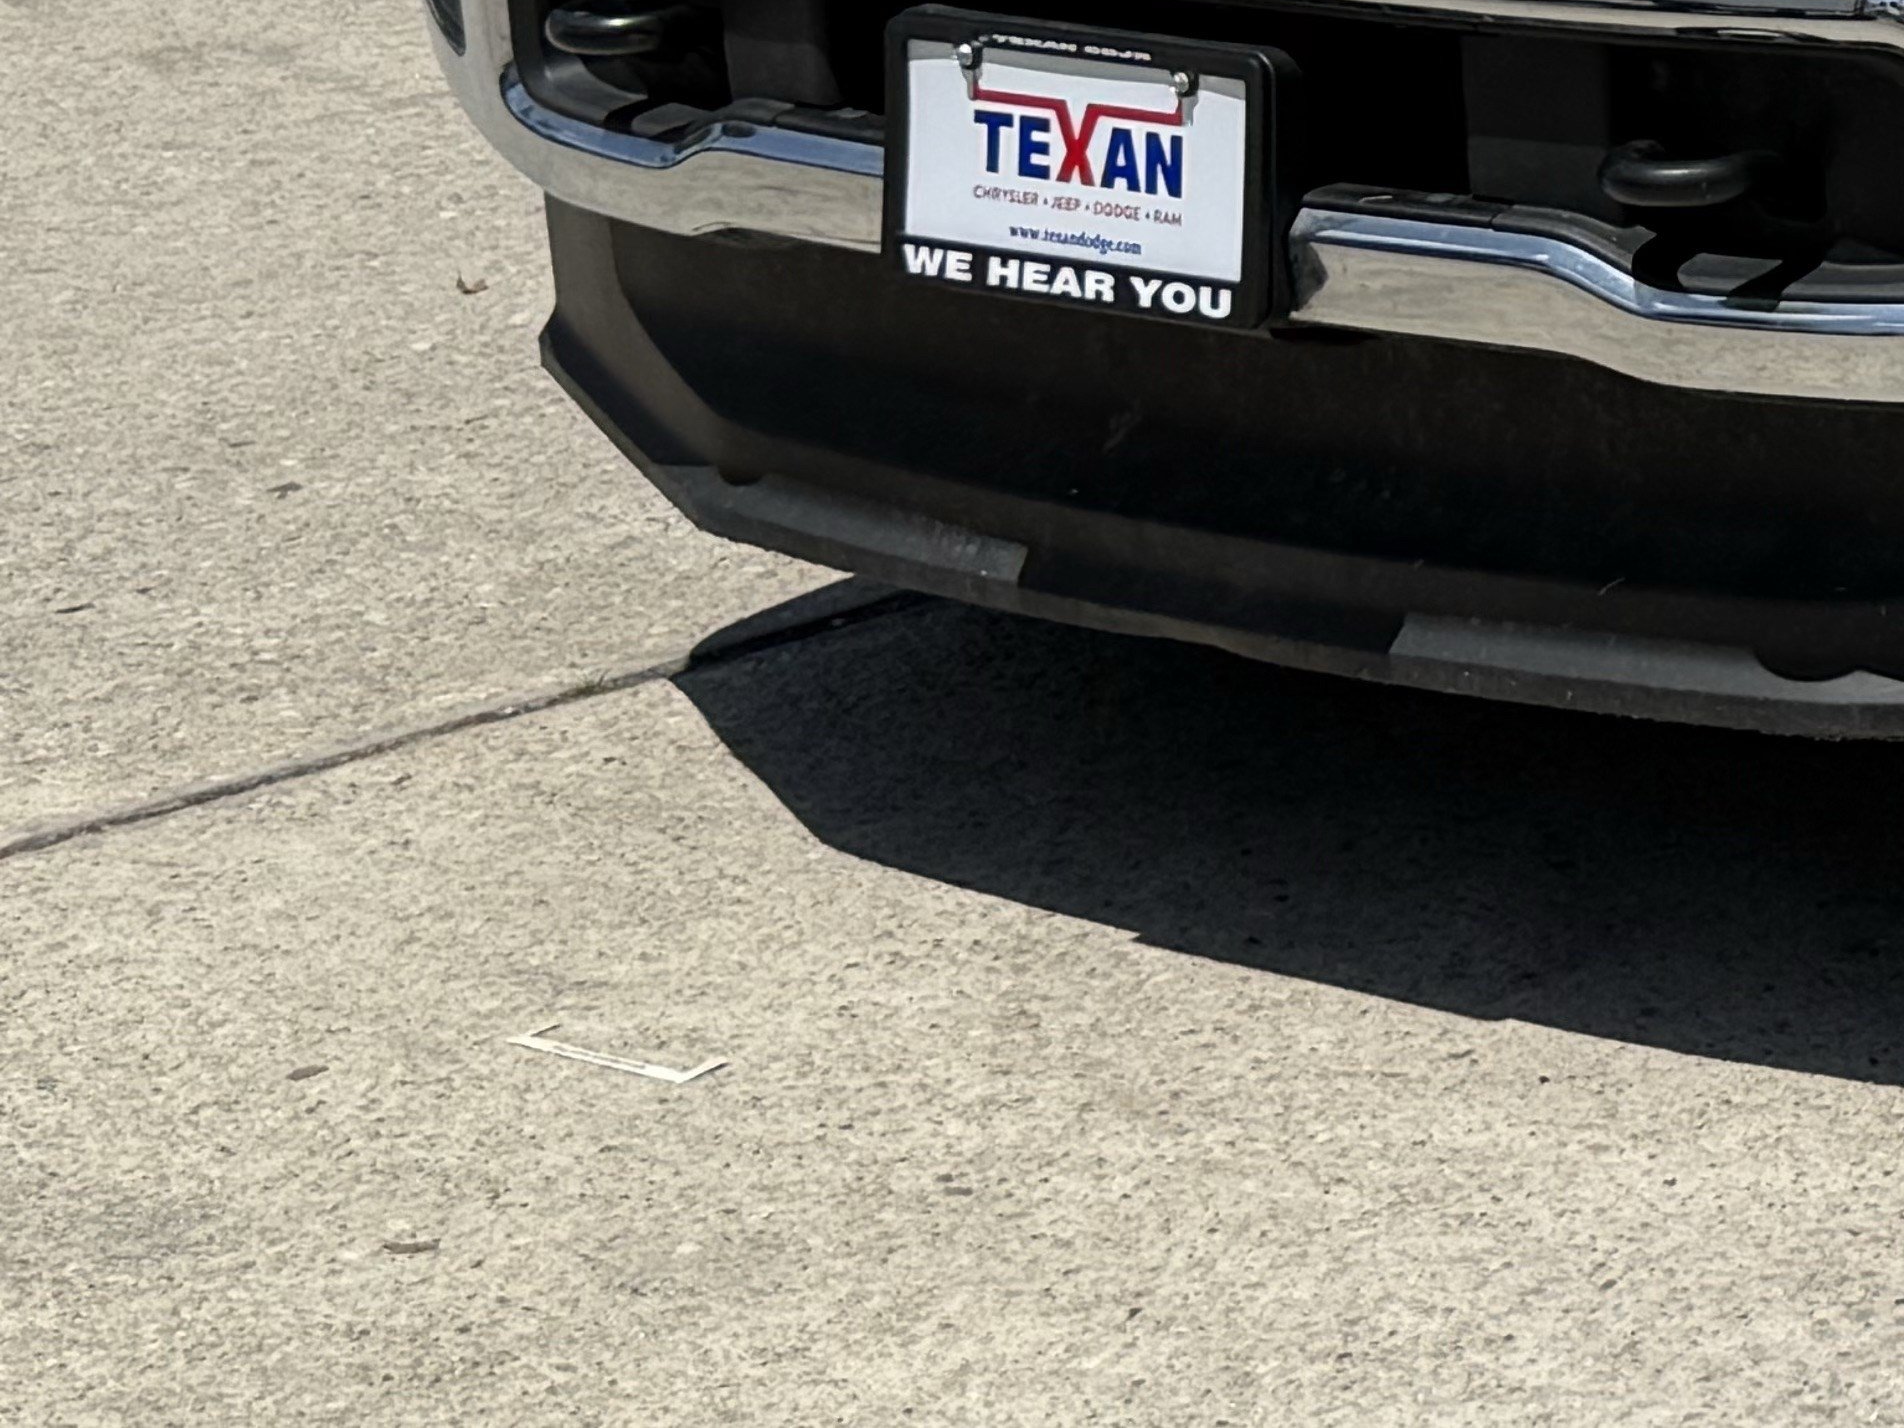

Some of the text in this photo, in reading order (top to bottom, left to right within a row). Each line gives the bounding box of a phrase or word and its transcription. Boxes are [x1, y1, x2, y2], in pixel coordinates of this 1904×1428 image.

[973, 102, 1184, 199] TEXAN
[972, 183, 1183, 227] CHRYSLER JEEP DODGE RAM
[1008, 223, 1142, 256] www.texandodge.com
[904, 244, 1232, 320] WE HEAR YOU
